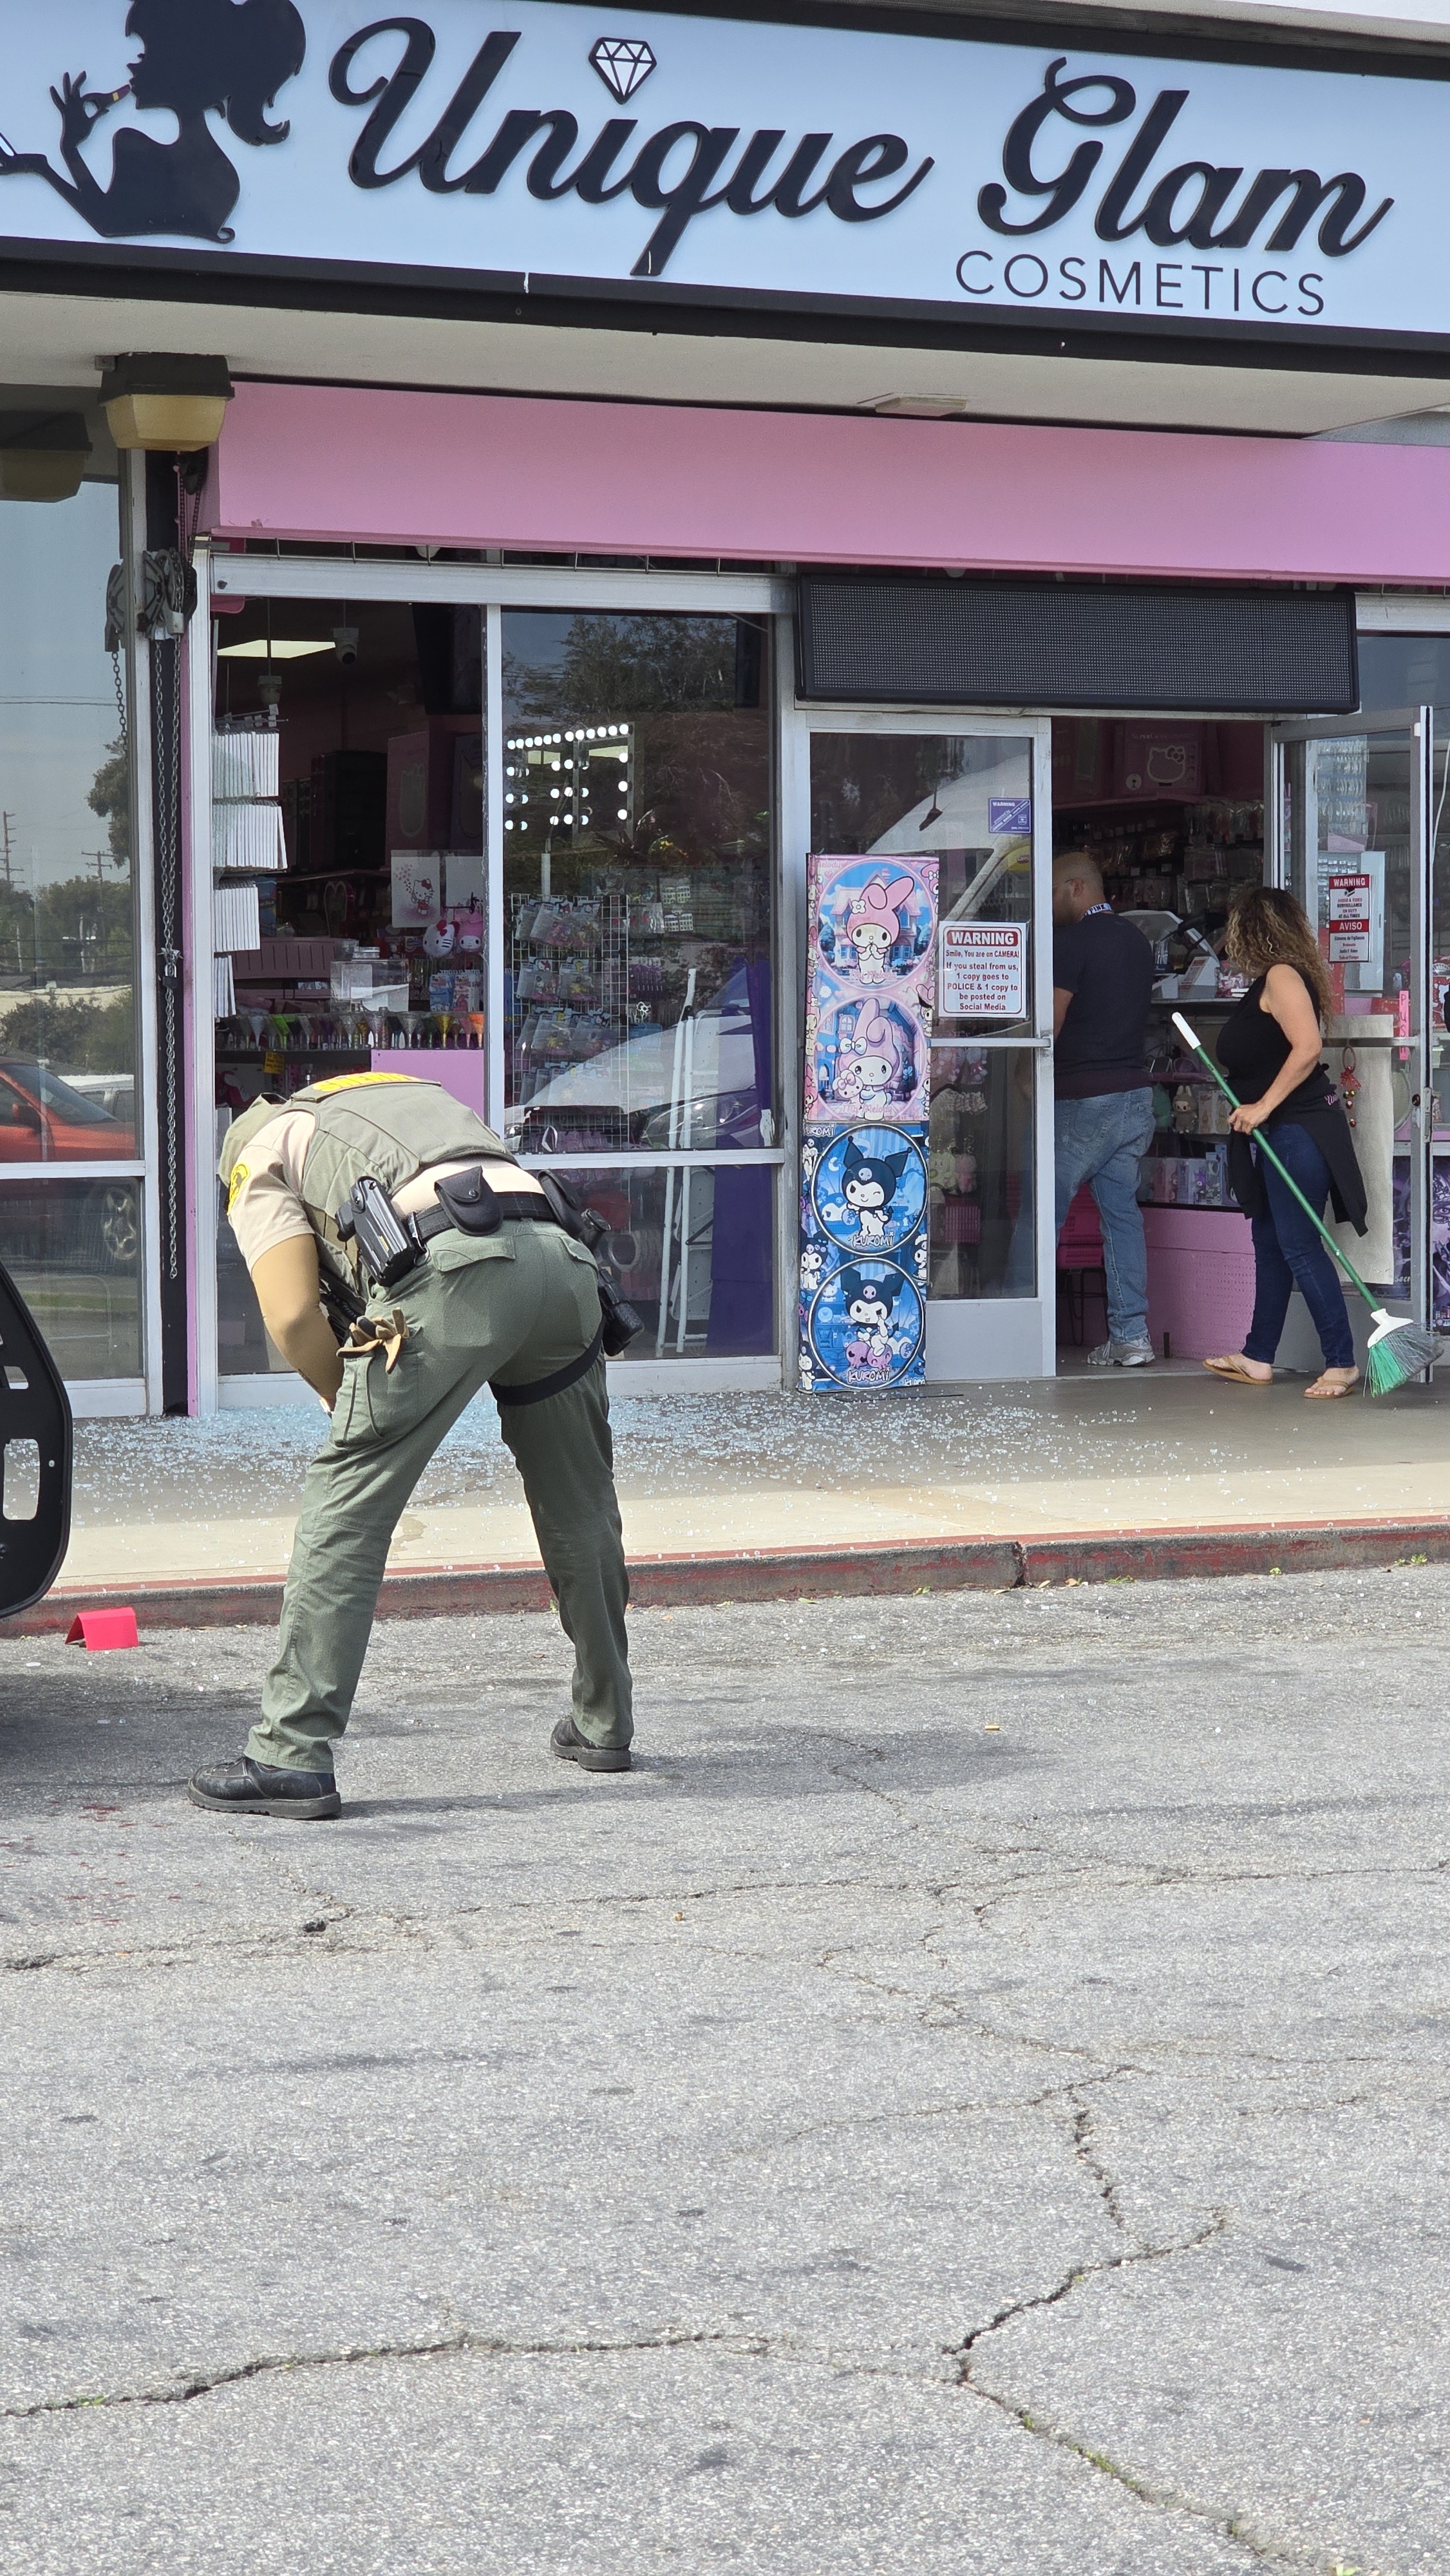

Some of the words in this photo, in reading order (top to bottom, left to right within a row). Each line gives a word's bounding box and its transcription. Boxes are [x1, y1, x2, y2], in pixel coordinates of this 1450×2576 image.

[329, 17, 934, 276] Unique
[977, 57, 1395, 257] Glam
[956, 251, 1325, 316] COSMETICS
[1333, 878, 1366, 887] WARNING
[1339, 922, 1362, 930] AVISO
[952, 932, 1014, 945] WARNING
[867, 967, 897, 981] Melody
[862, 1104, 892, 1114] Melody
[805, 1124, 836, 1137] UROMI
[852, 1230, 894, 1249] KUROMI
[847, 1366, 892, 1383] KUROMI
